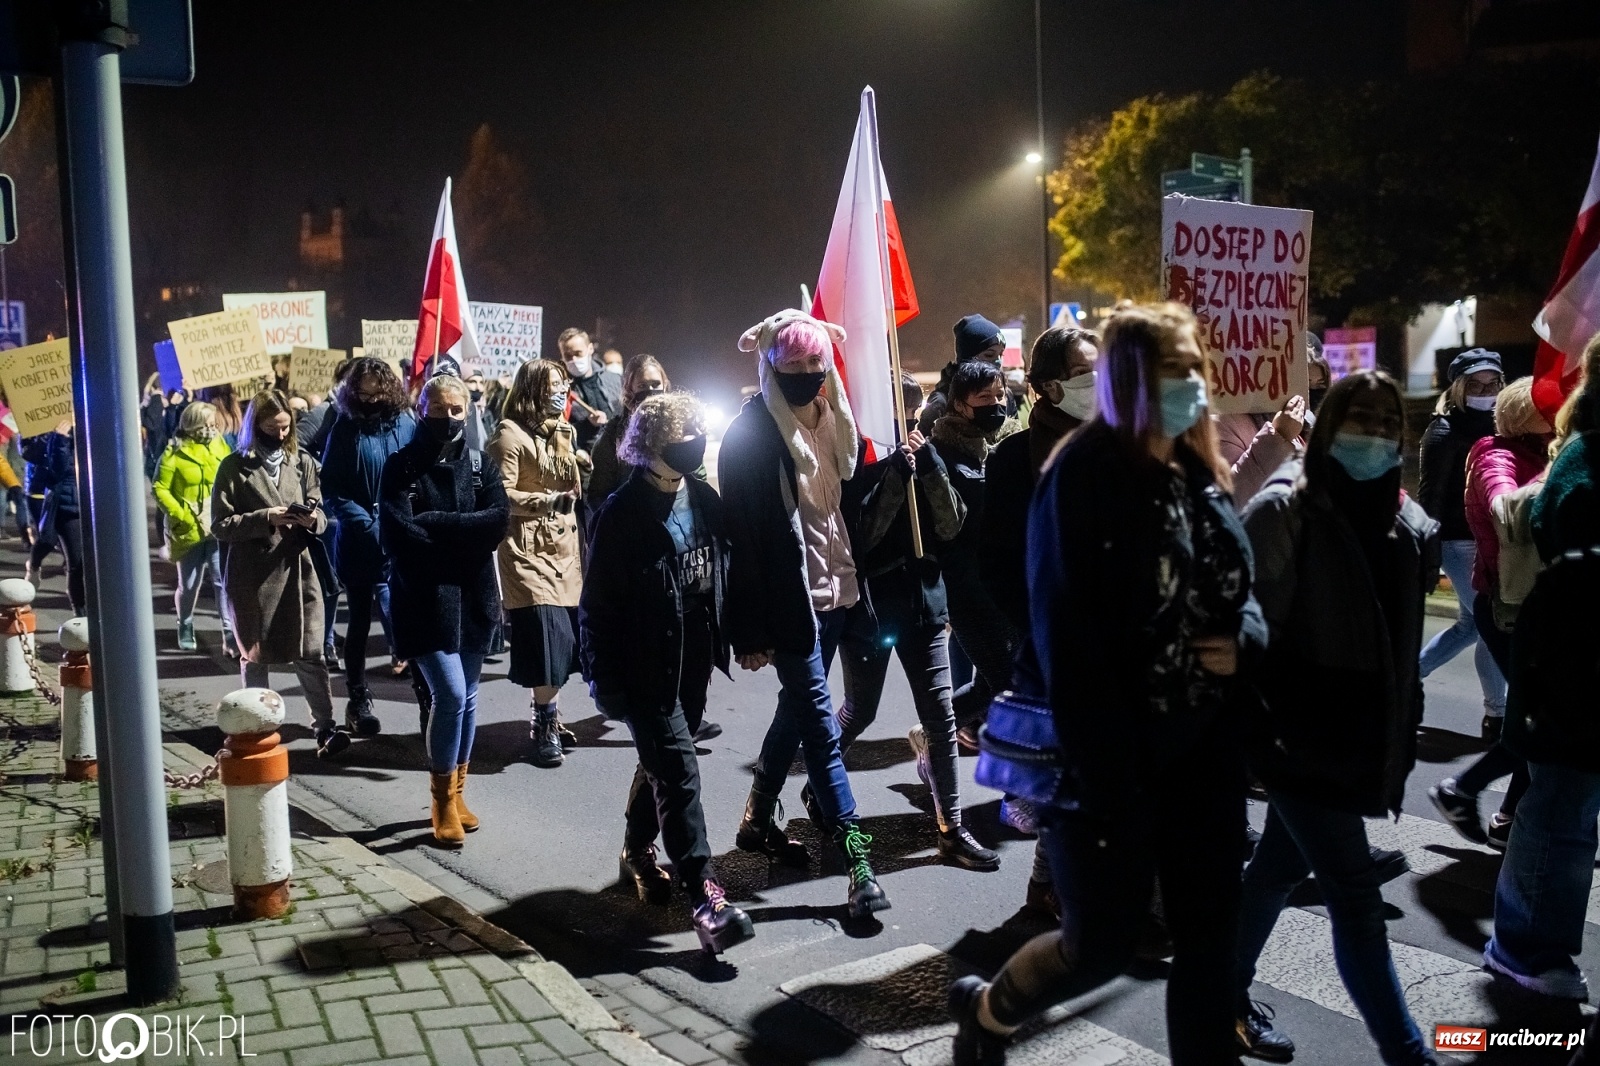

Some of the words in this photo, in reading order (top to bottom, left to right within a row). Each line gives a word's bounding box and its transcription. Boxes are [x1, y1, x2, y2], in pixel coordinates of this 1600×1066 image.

[1175, 221, 1266, 271] DOSTĘP
[1274, 229, 1306, 264] DO
[513, 309, 540, 323] PIEKLE
[181, 328, 209, 344] POZA
[365, 324, 392, 335] JAREK
[397, 323, 408, 335] TO
[518, 323, 539, 336] JEST
[364, 336, 386, 346] WINA
[27, 350, 64, 369] JAREK
[200, 343, 224, 360] MAM
[192, 361, 223, 384] MÓZG
[223, 361, 229, 377] I
[230, 354, 263, 376] SERCE
[11, 368, 59, 390] KOBIETA
[683, 546, 710, 568] POST
